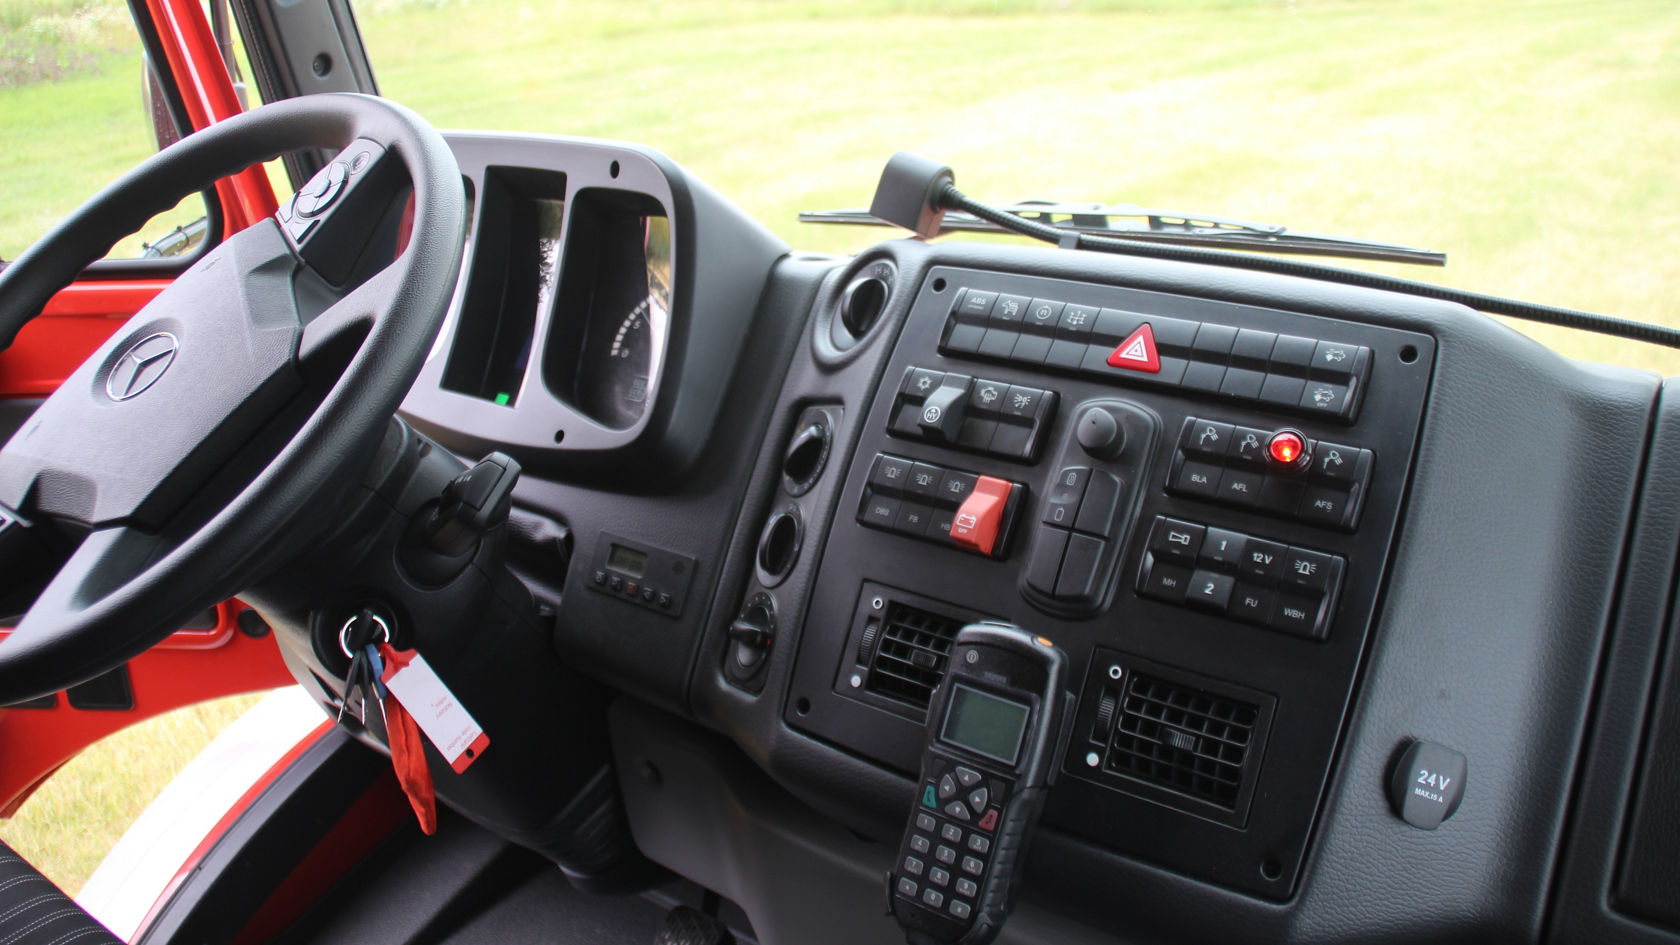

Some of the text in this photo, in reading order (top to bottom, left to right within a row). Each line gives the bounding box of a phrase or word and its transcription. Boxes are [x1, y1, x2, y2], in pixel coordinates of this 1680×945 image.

[971, 297, 986, 305] ABS
[1191, 474, 1208, 484] BLA
[1232, 482, 1248, 492] AFL
[1315, 499, 1333, 510] AFS
[1220, 540, 1227, 551] 1
[1163, 577, 1176, 588] MH
[1204, 583, 1215, 595] 2
[1245, 598, 1258, 608] FU
[1284, 608, 1305, 620] WBH
